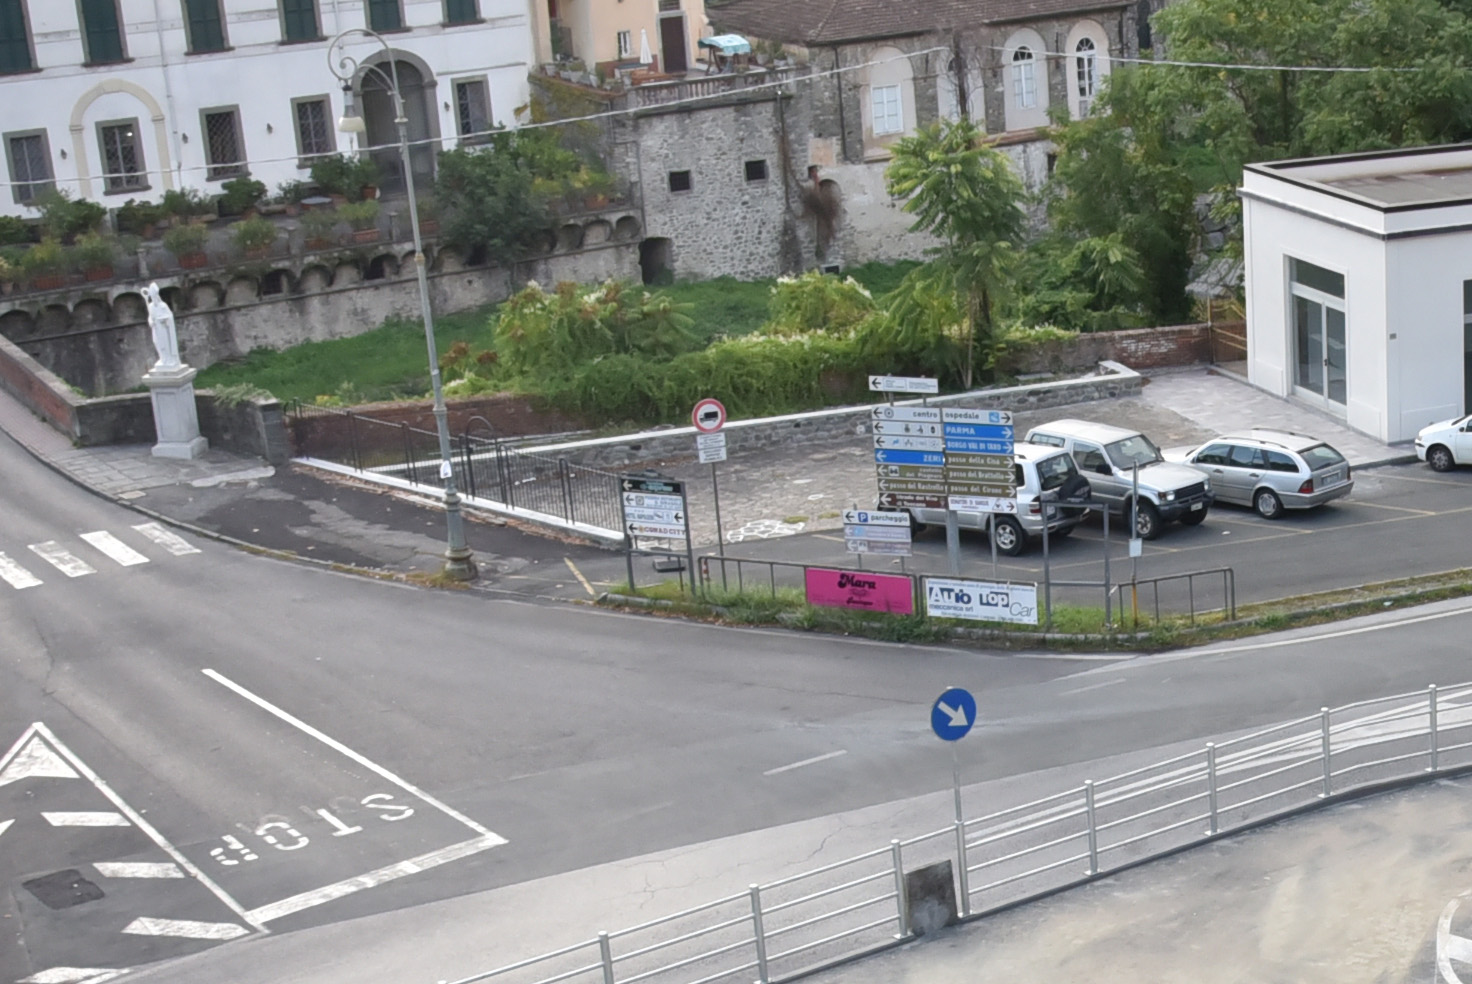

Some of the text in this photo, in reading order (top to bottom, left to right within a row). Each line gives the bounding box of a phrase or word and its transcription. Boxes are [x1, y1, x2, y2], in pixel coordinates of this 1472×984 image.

[912, 411, 938, 419] centro
[945, 411, 980, 420] ospedale
[946, 426, 976, 435] PARMA
[947, 441, 967, 449] BORGO
[968, 442, 978, 450] VAL
[923, 454, 942, 462] ZERI
[948, 456, 1000, 465] passo della Cisa
[870, 513, 908, 523] parcheggio
[837, 573, 876, 589] Mara
[929, 603, 964, 612] meccanica
[1009, 602, 1035, 617] Car
[209, 793, 415, 866] STOP
